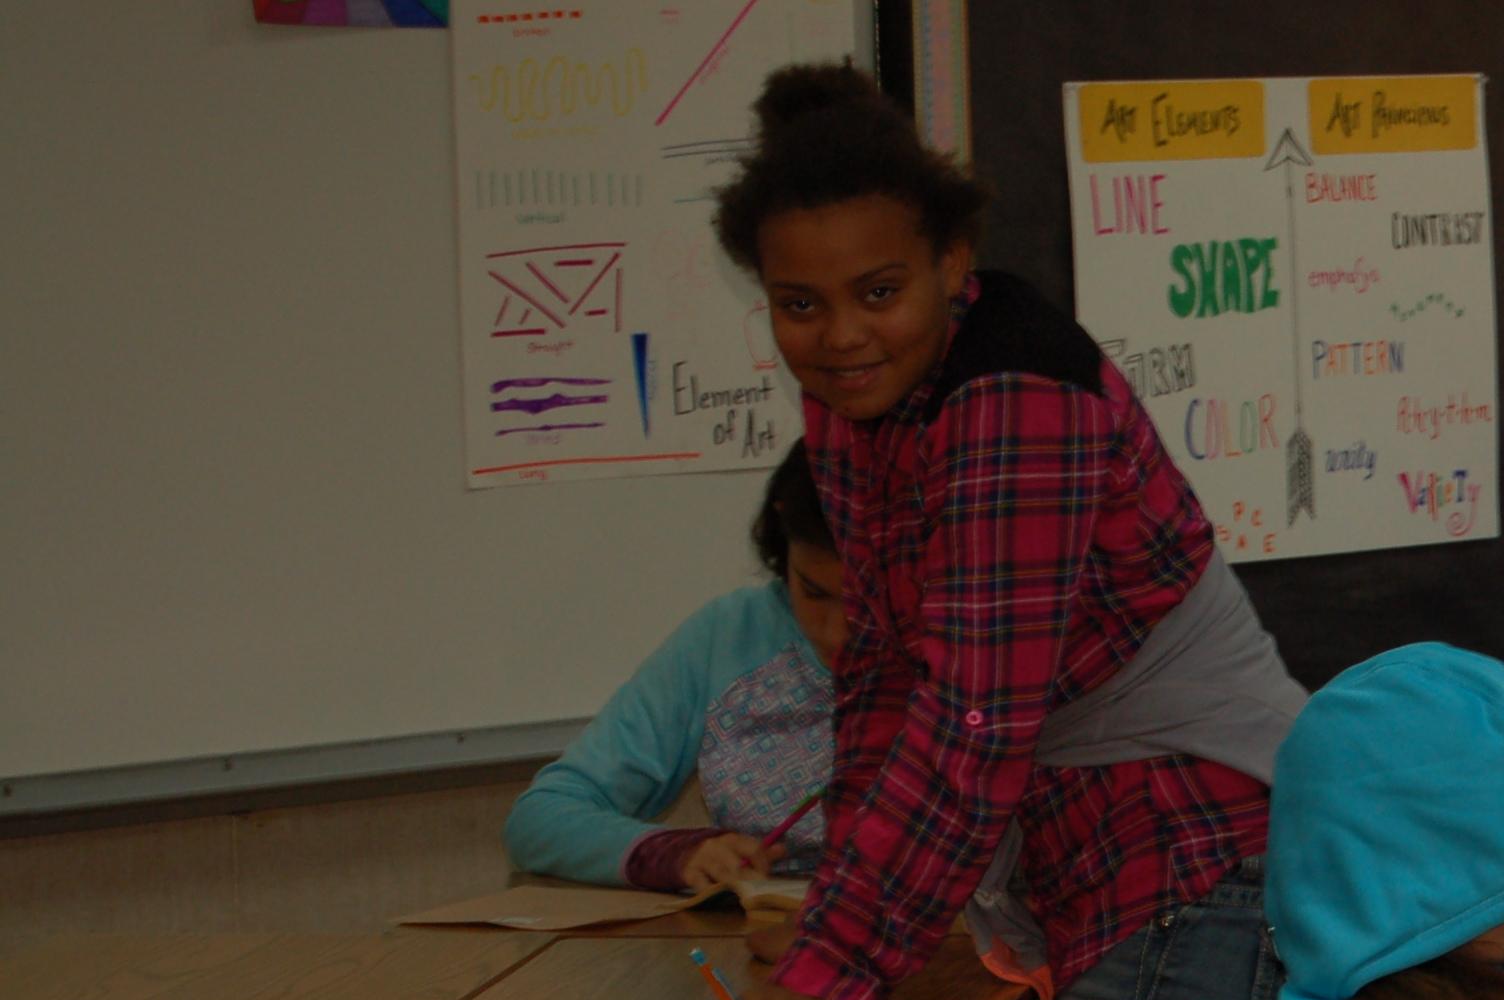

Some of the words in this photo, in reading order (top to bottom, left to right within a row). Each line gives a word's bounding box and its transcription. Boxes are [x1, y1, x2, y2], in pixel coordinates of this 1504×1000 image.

[1089, 174, 1168, 235] LINE
[1306, 173, 1378, 202] BALANCE
[1391, 212, 1486, 250] CONTRAST
[1168, 238, 1280, 319] SHAPE
[1312, 339, 1404, 379] PATTERN
[672, 360, 775, 416] Element
[713, 408, 738, 446] of
[742, 408, 777, 458] Art
[1185, 393, 1279, 460] COLOR
